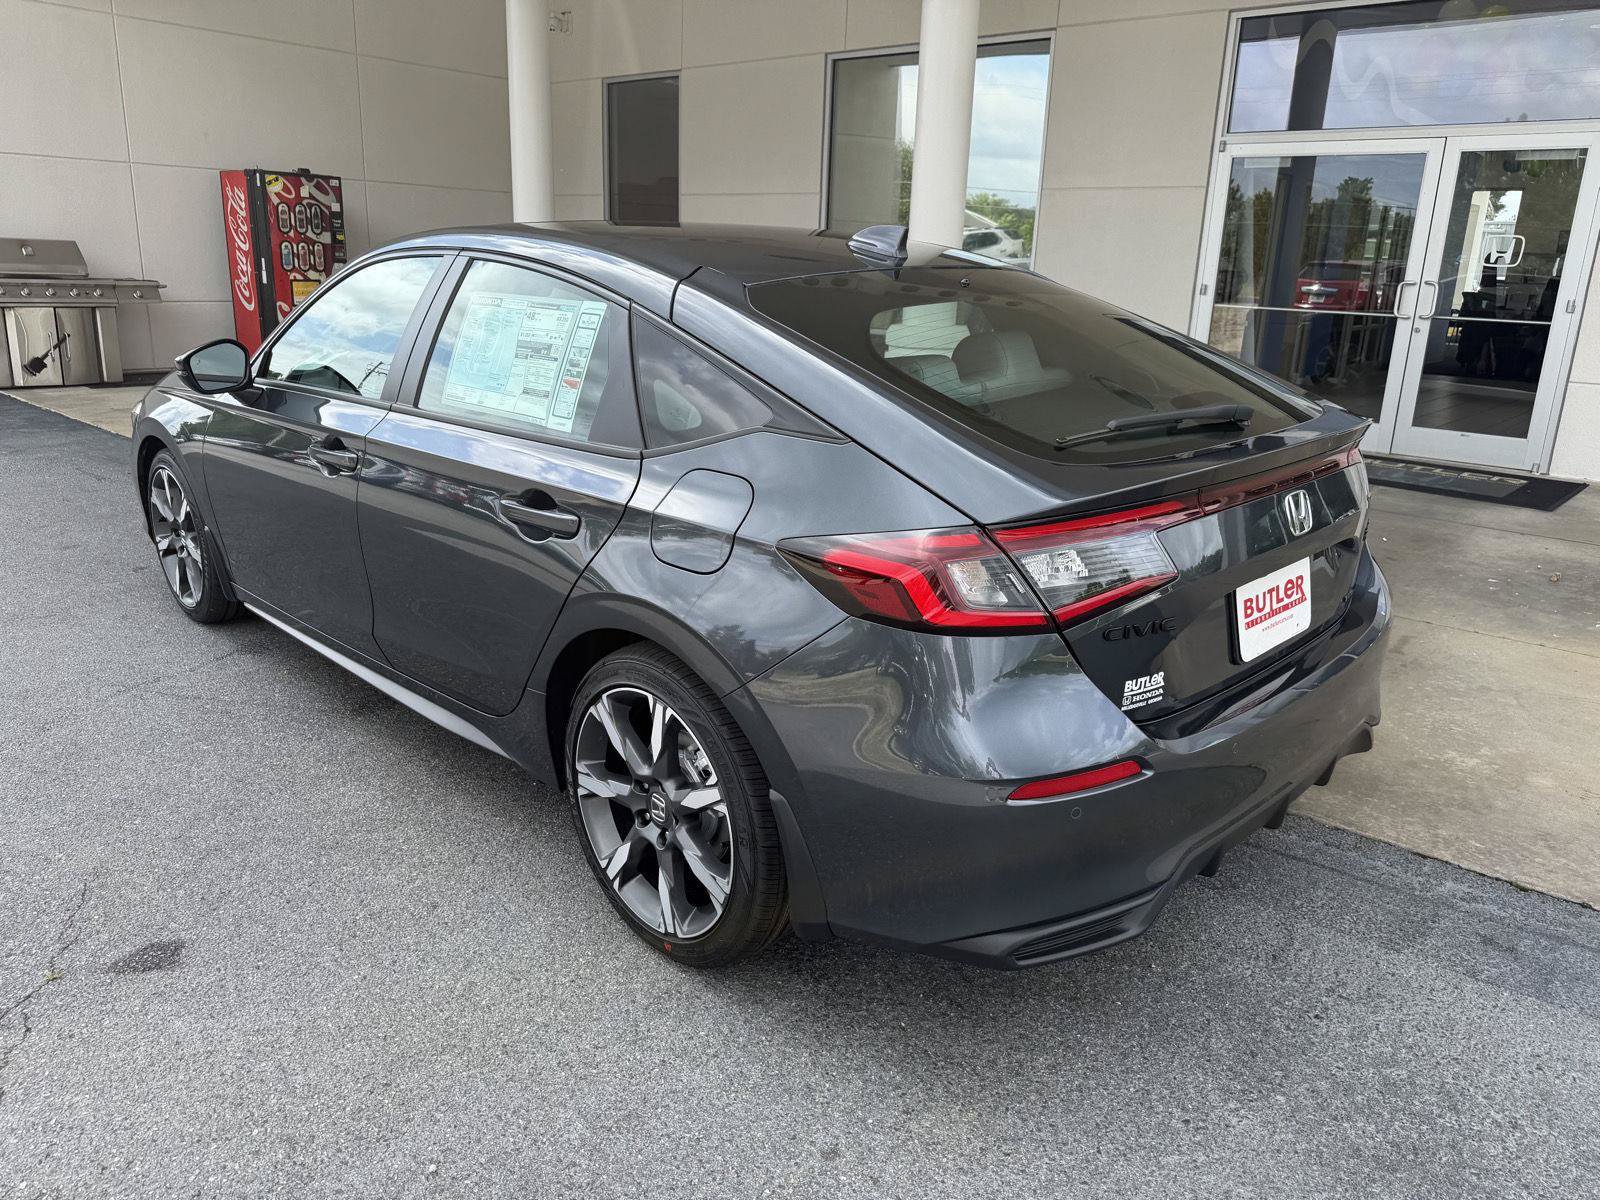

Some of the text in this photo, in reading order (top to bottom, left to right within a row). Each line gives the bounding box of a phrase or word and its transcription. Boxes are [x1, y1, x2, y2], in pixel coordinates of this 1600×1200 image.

[225, 179, 255, 311] Coca-Cola
[1102, 616, 1177, 641] CIVIC
[1132, 688, 1164, 703] HONDA
